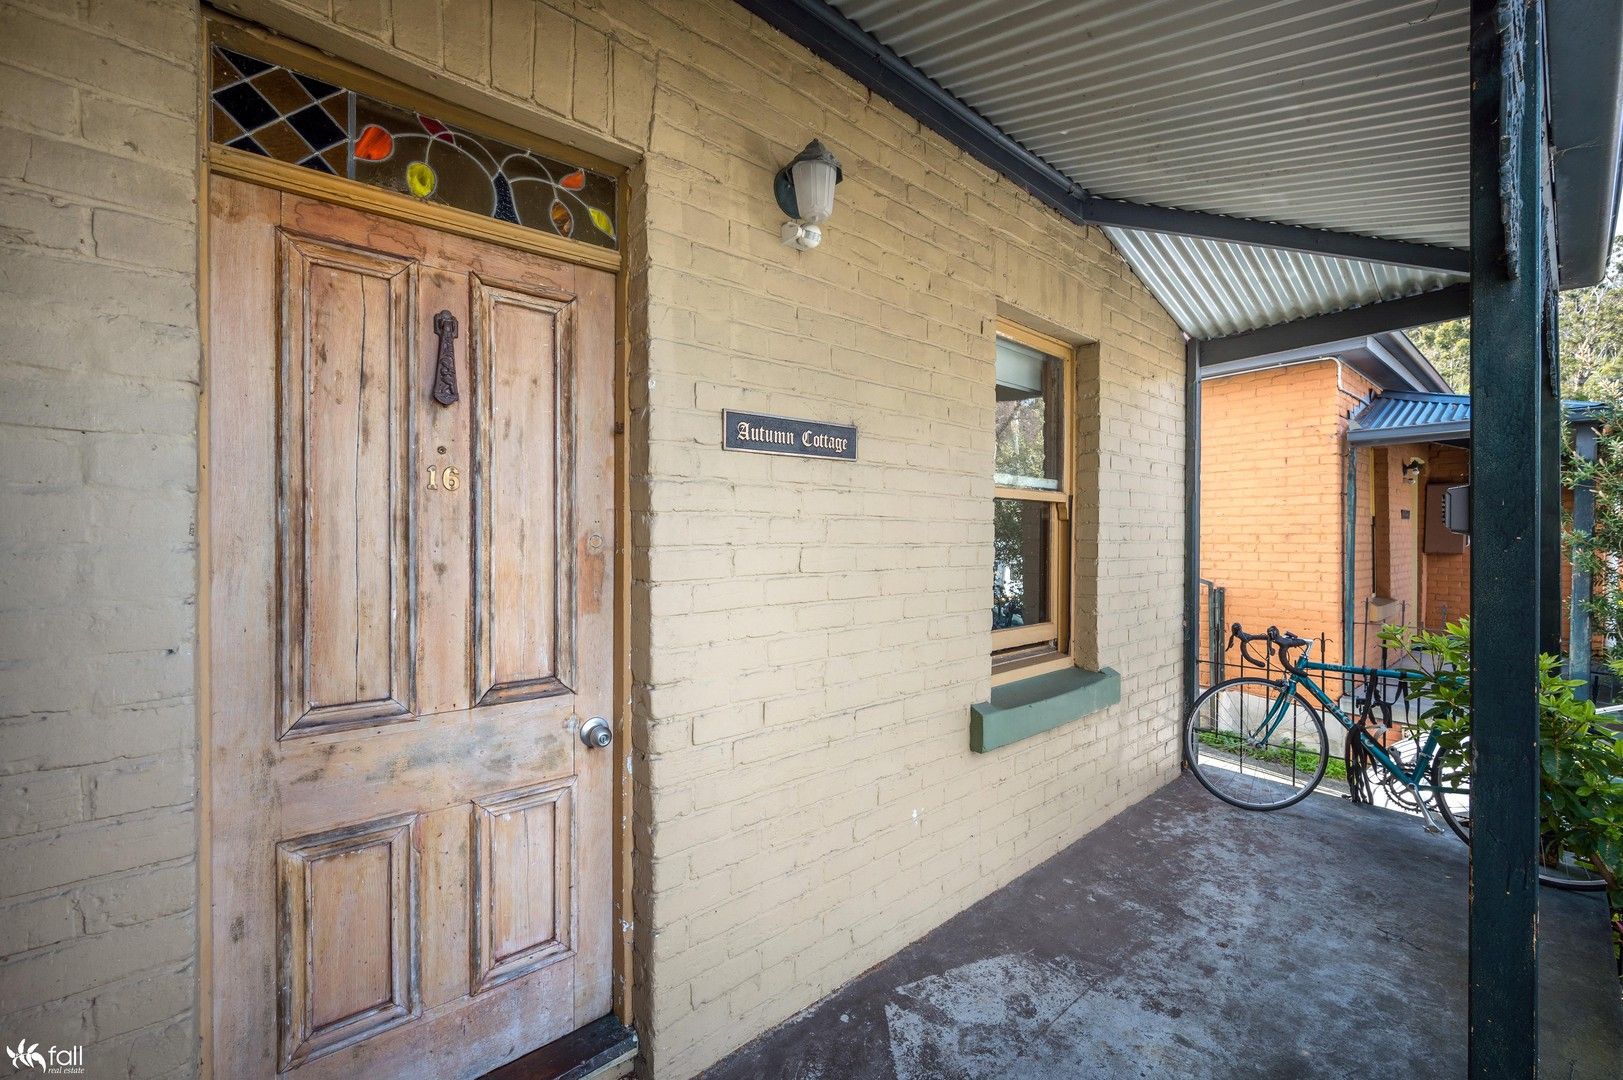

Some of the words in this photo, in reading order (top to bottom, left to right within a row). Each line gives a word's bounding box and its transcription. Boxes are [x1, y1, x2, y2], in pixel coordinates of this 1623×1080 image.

[737, 422, 795, 445] Autumn
[801, 430, 849, 453] Cottage
[427, 465, 460, 491] 16
